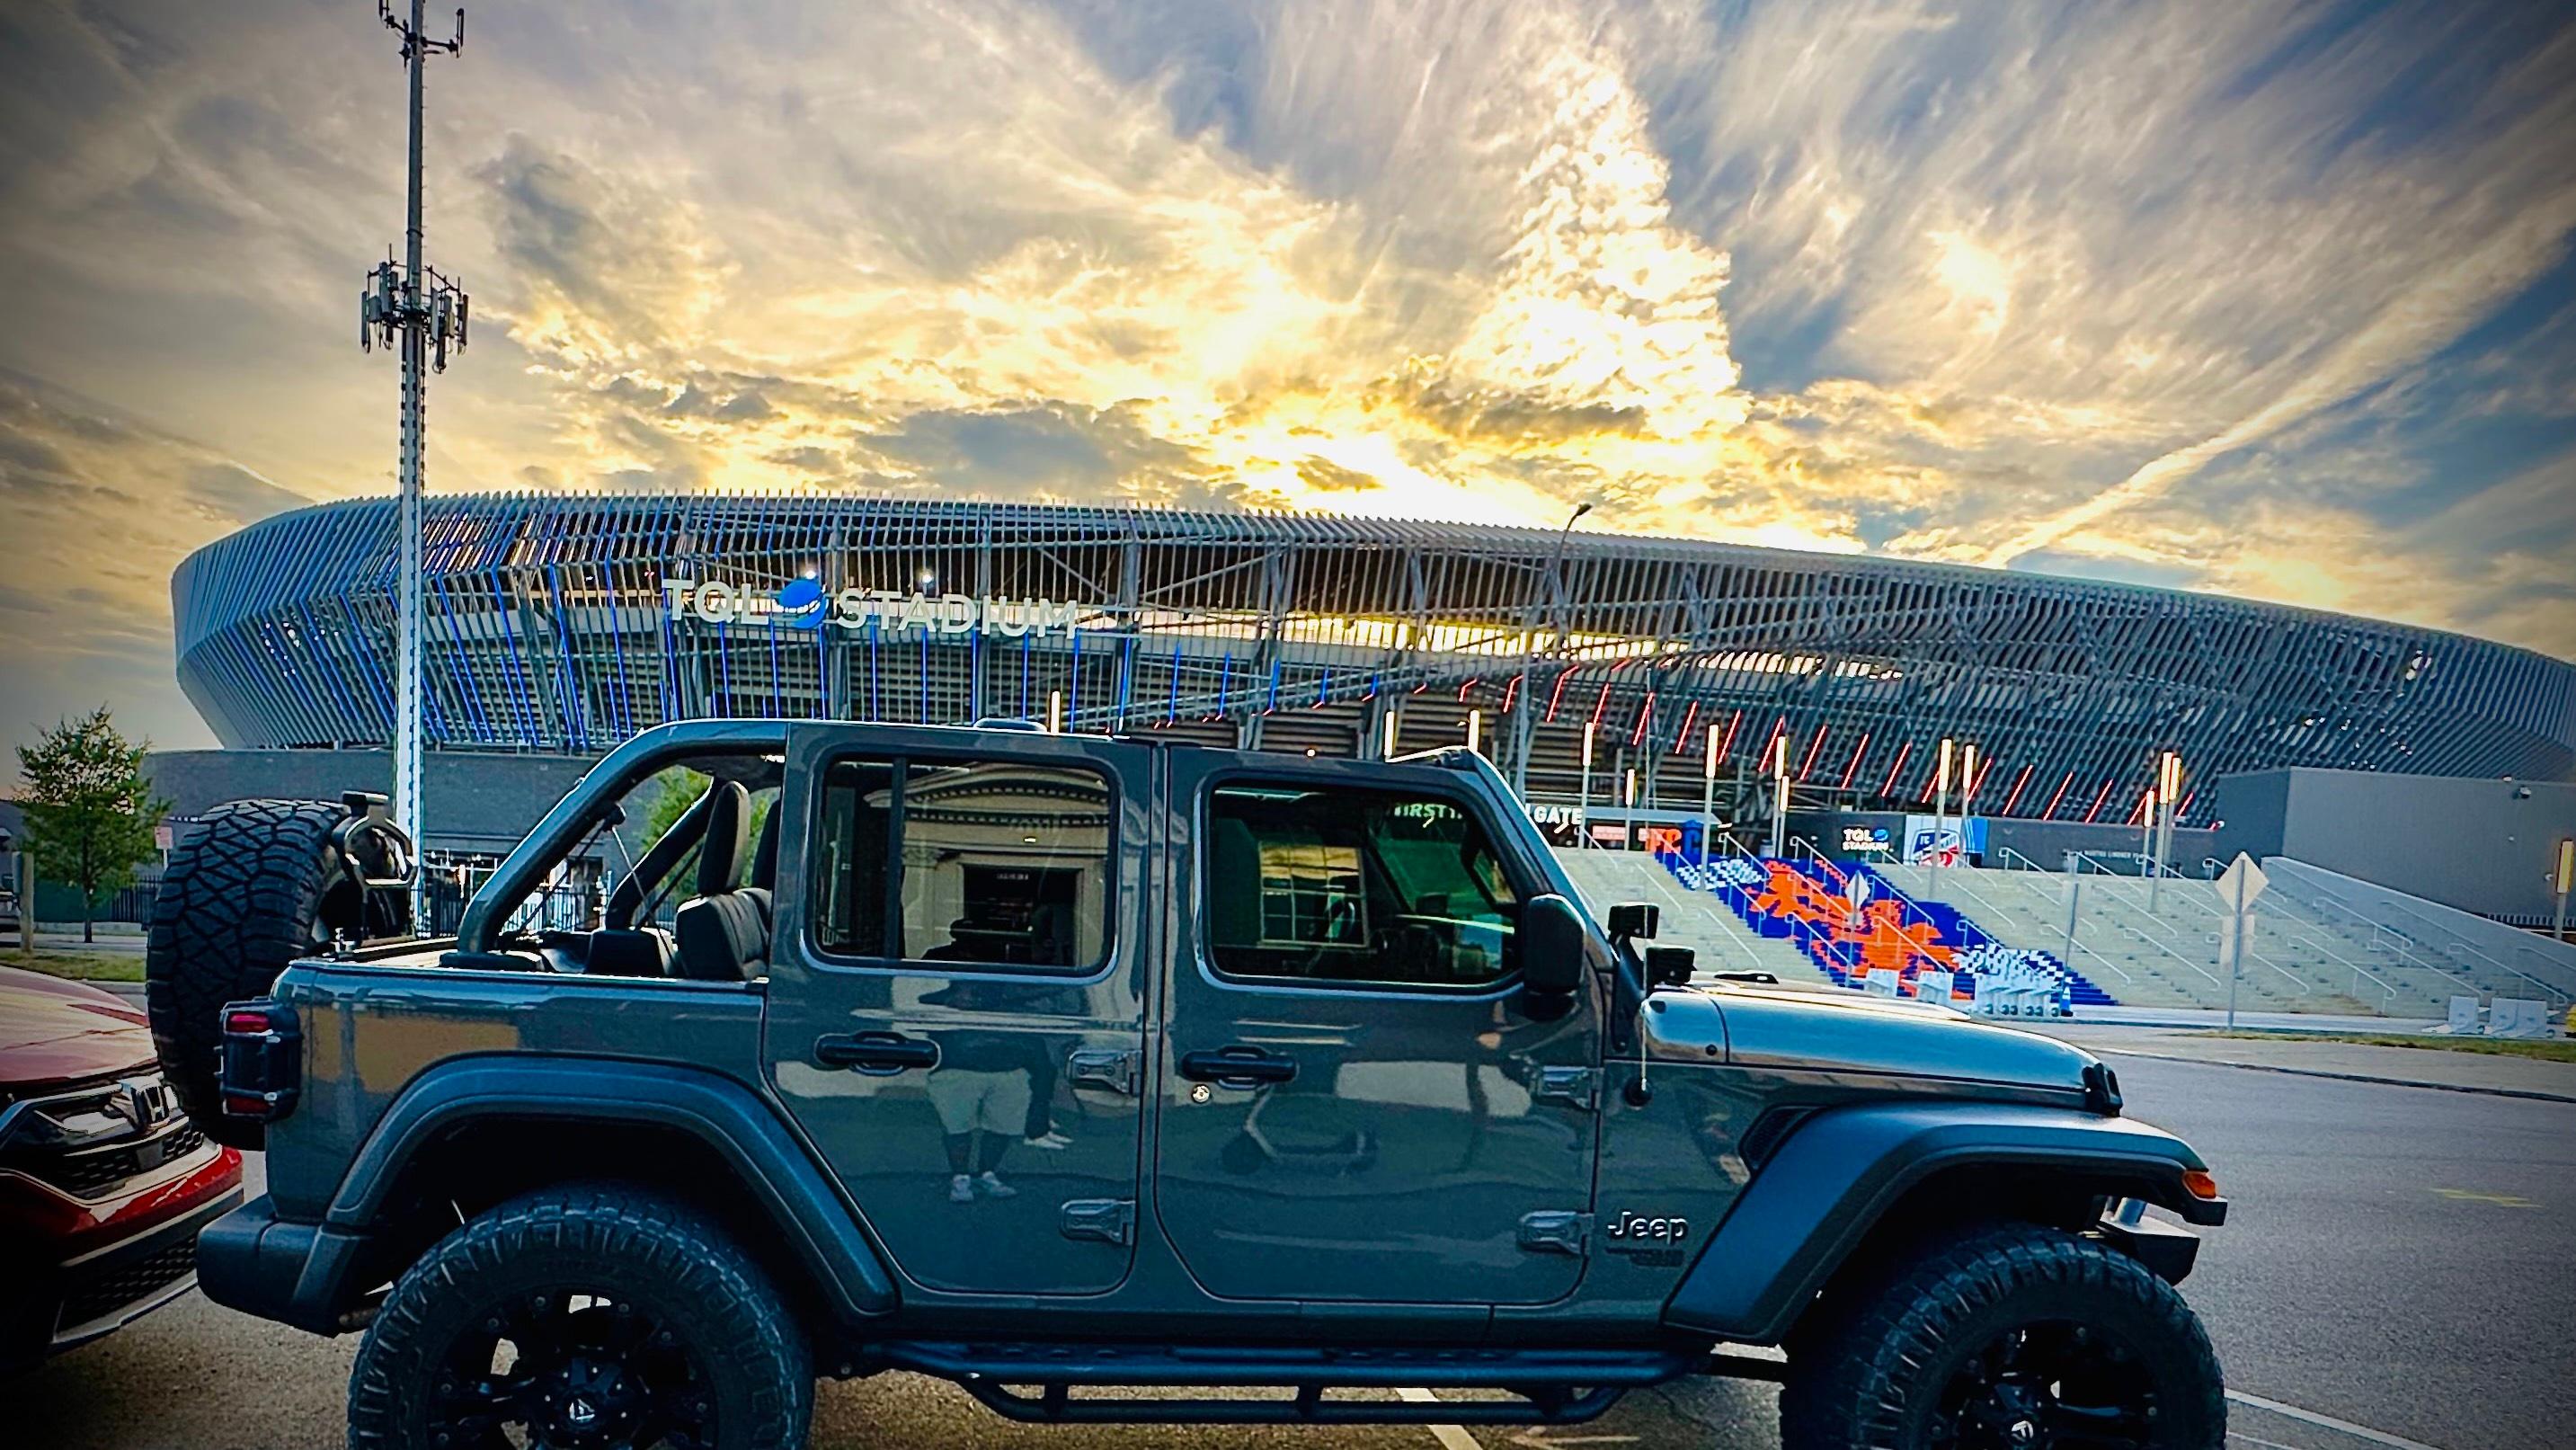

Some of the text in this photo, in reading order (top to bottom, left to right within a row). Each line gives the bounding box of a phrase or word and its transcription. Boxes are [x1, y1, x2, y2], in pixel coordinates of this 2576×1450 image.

[662, 579, 1078, 640] TQL STADIUM
[1533, 805, 1583, 825] GATE
[1843, 828, 1874, 842] TQL
[1607, 1211, 1688, 1245] Jeep
